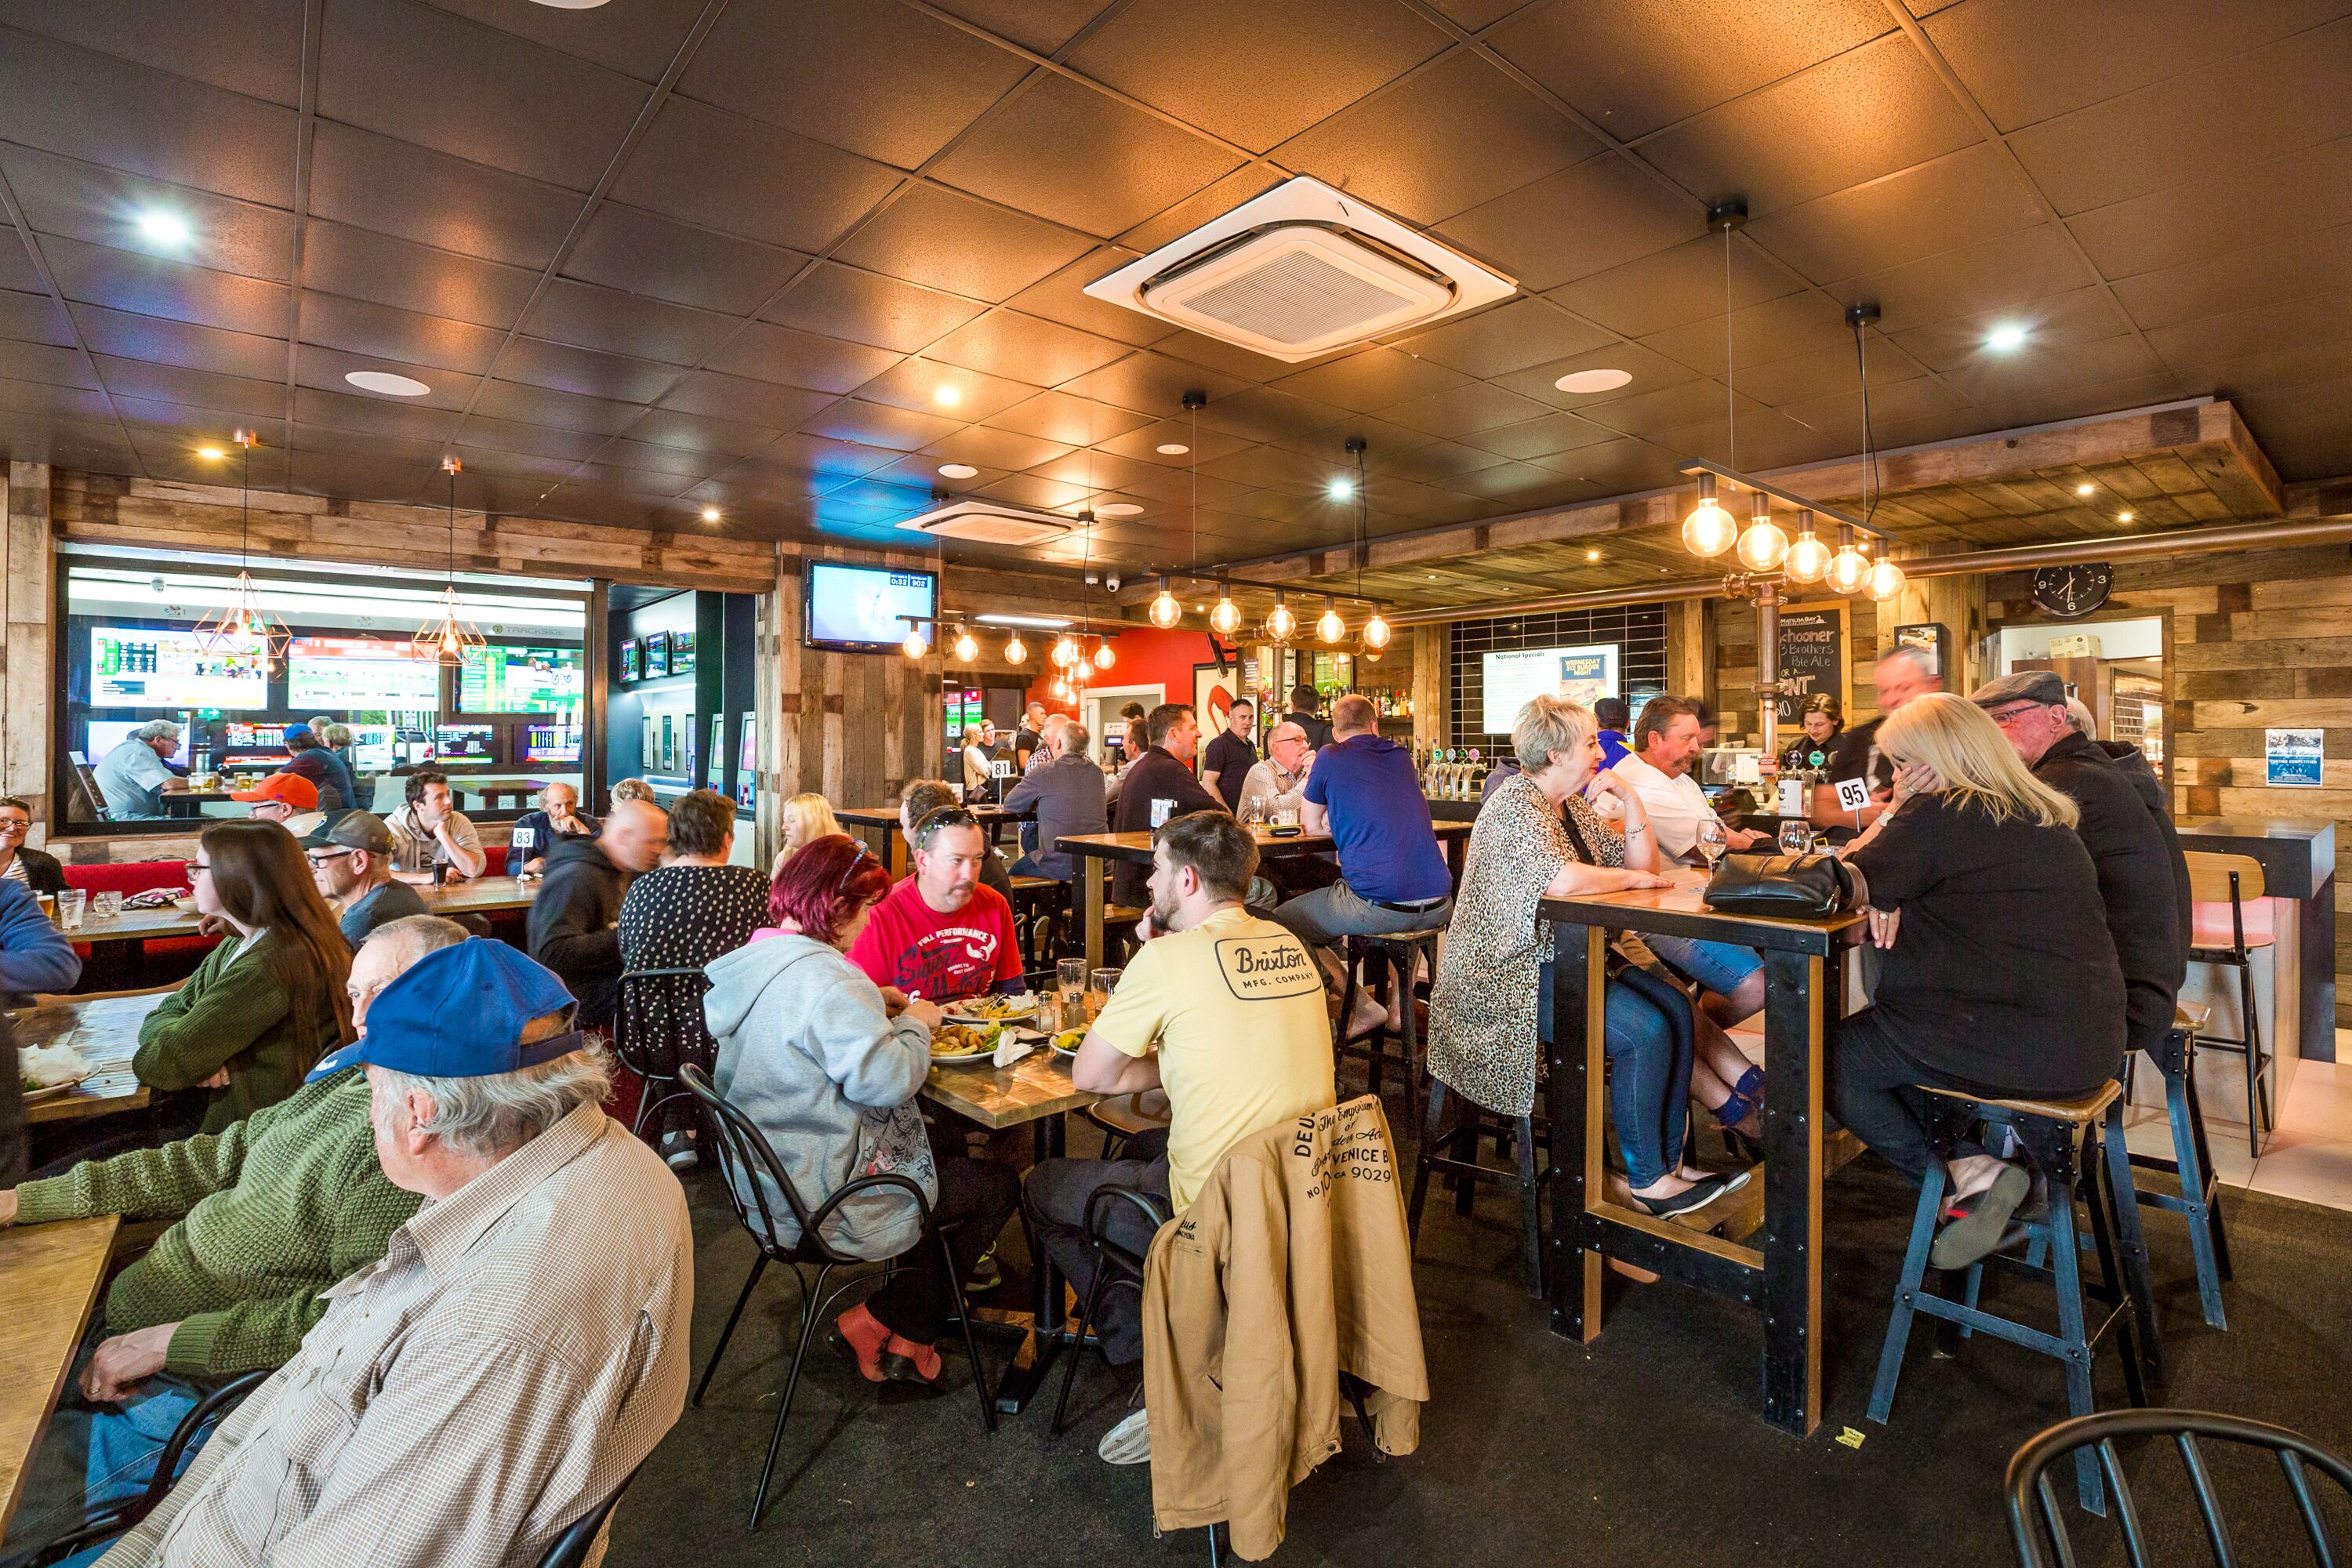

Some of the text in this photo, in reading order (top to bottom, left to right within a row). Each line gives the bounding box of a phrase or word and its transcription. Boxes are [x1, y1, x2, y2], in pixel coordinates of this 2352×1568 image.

[2098, 575, 2107, 584] 3
[2067, 602, 2076, 611] 6
[506, 627, 565, 636] TRACKSIDE
[1780, 629, 1835, 643] chooner
[1781, 643, 1834, 656] 3 Brothers
[1791, 655, 1809, 666] Pale
[1780, 668, 1790, 677] OR
[995, 764, 1007, 775] 81
[1842, 784, 1864, 806] 95
[516, 832, 530, 844] 83
[917, 934, 935, 947] FULL
[935, 927, 988, 942] PERFORMANCE
[1235, 945, 1306, 973] Brixton
[1243, 972, 1314, 988] MFG. COMPANY
[1318, 1100, 1374, 1131] The Emporium
[1294, 1112, 1315, 1157] DEU
[1333, 1148, 1379, 1165] VENICE
[1383, 1150, 1389, 1163] B
[1352, 1166, 1392, 1182] 9029
